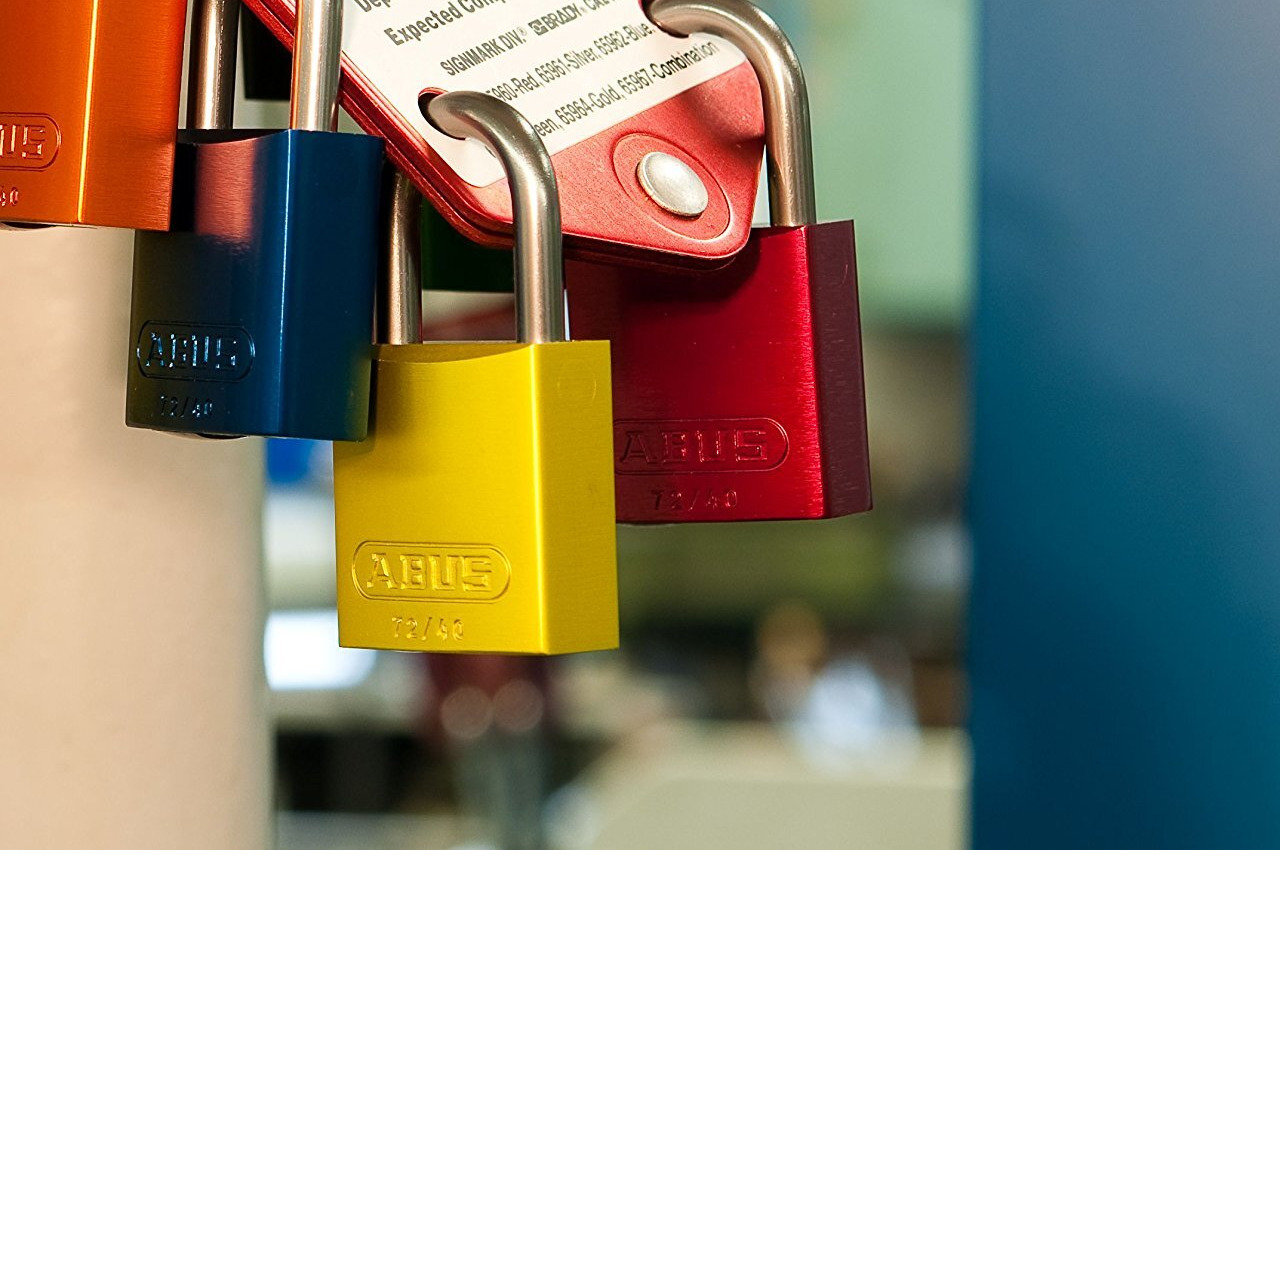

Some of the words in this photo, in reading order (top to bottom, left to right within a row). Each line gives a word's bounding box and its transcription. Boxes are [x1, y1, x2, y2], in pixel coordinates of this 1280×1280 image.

[384, 1, 463, 46] Expected
[440, 39, 506, 76] SIGNMARK
[485, 72, 545, 101] 960-Red,
[534, 116, 563, 137] een,
[146, 332, 240, 372] ABUS
[620, 428, 768, 464] ABUS
[650, 488, 738, 511] 72/40
[366, 552, 492, 593] ABUS
[391, 616, 465, 641] 72/40
